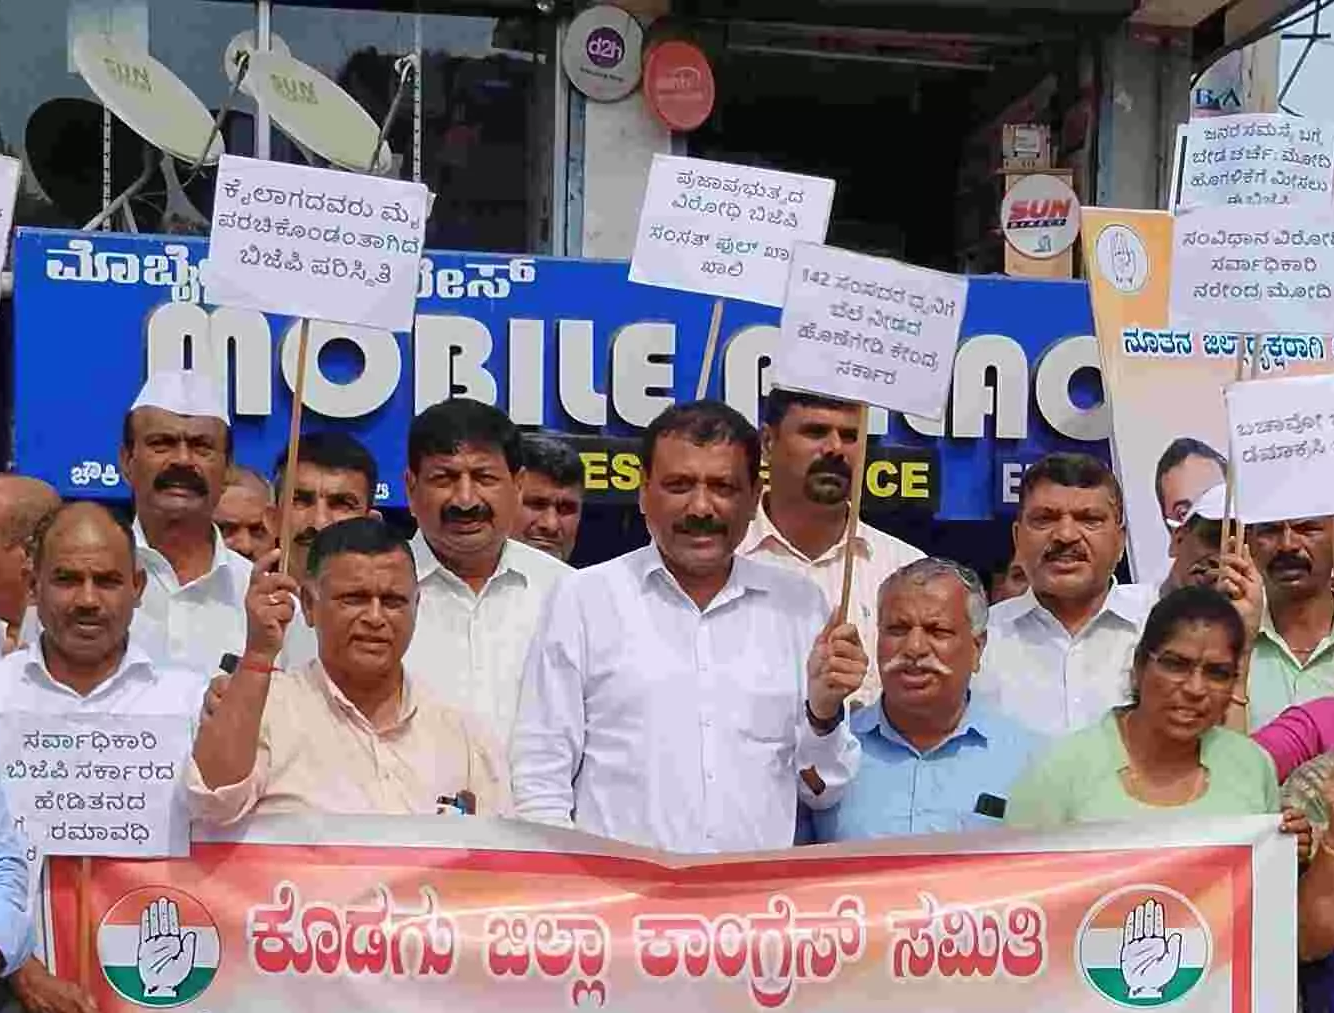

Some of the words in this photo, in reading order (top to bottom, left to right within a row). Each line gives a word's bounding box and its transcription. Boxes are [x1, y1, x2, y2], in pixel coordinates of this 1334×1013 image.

[588, 36, 622, 59] d2h
[223, 179, 373, 218] ಕೈಲಾಗದವರು
[676, 170, 803, 204] ಪ್ರಜಾಪ್ರಭುತ್ವದ
[671, 193, 741, 221] ವಿರೋಧಿ
[749, 205, 798, 228] ಬಿಜೆಪಿ
[1182, 230, 1269, 248] ಸಂವಿಧಾನ
[240, 244, 303, 271] ಬಿಜೆಪಿ
[763, 246, 789, 261] ಖಾ
[1211, 256, 1317, 274] ಸರ್ವಾಧಿಕಾರಿ
[46, 240, 209, 304] ಮೊಬೈ
[1193, 281, 1262, 300] ನರೇಂದ್ರ
[1268, 281, 1331, 299] ಮೋದಿ
[147, 302, 675, 430] MOBILE
[23, 730, 157, 753] ಸರ್ವಾಧಿಕಾರಿ
[7, 760, 69, 780] ಬಿಜೆಪಿ
[75, 761, 175, 781] ಸರ್ಕಾರದ
[35, 790, 146, 811] ಹೇಡಿತನದ
[49, 822, 149, 844] ರಮಾವಧಿ
[251, 881, 455, 977] ಕೊಡಗು
[486, 916, 608, 1007] ಜಿಲ್ಲಾ
[636, 896, 863, 1007] ಕಾಂಗ್ರೆಸ್
[890, 897, 1046, 979] ಸಮಿತಿ
